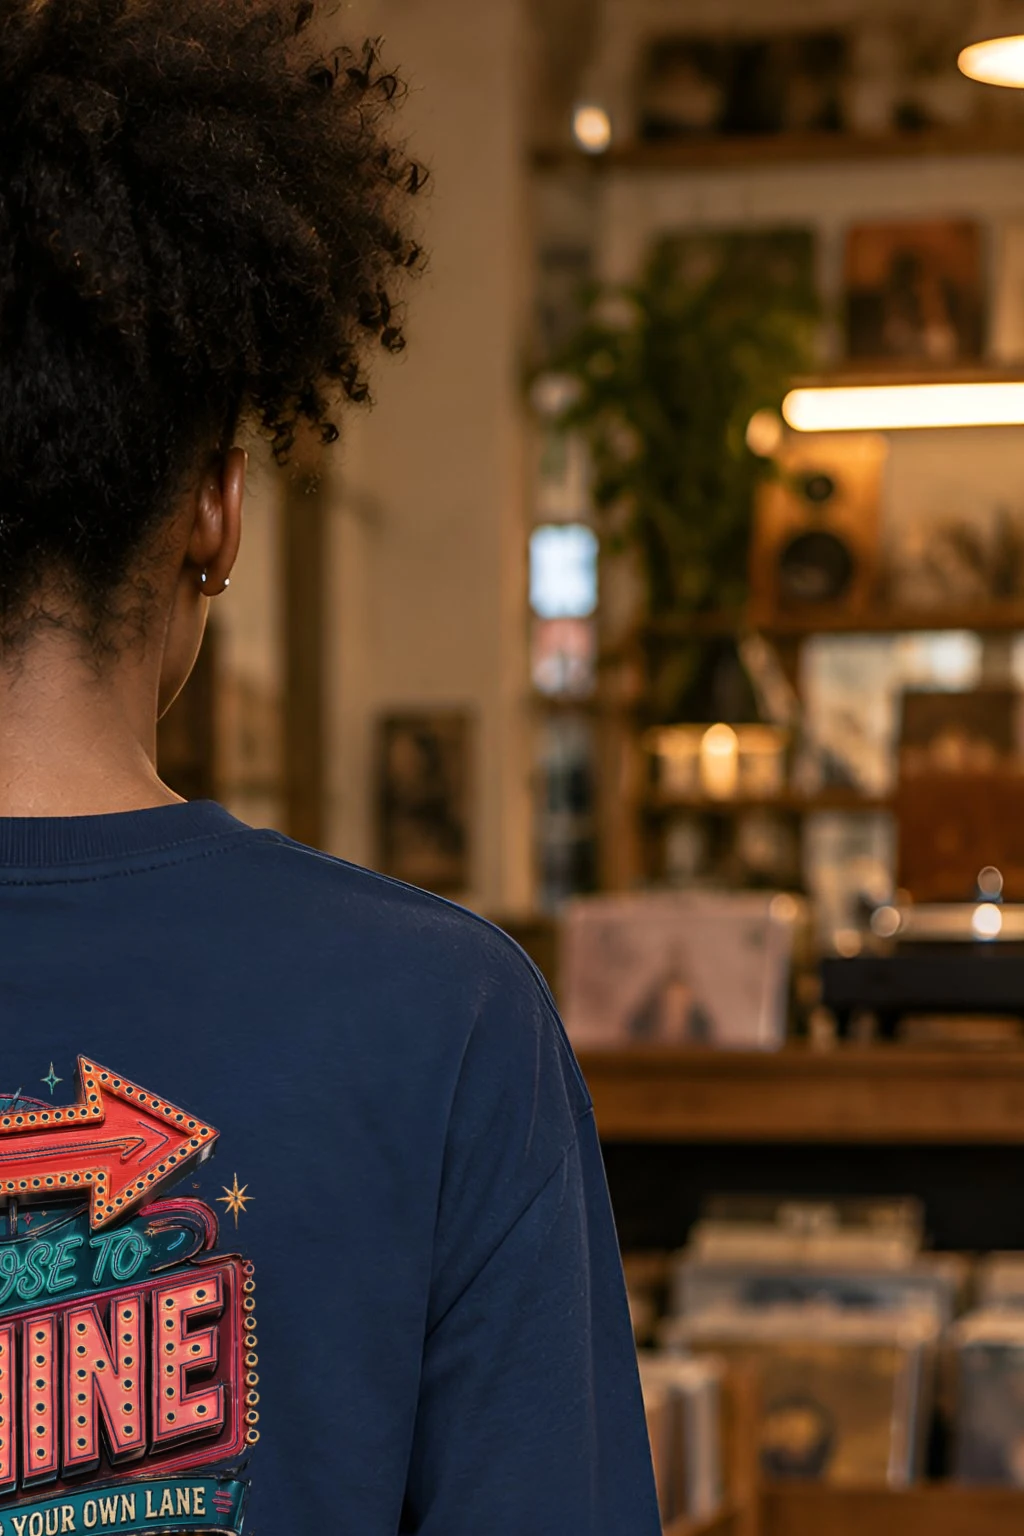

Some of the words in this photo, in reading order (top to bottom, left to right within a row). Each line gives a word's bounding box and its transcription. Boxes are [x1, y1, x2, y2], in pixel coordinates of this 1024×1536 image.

[90, 1227, 150, 1286] TO
[83, 1494, 137, 1528] OWN
[144, 1486, 207, 1518] LANE
